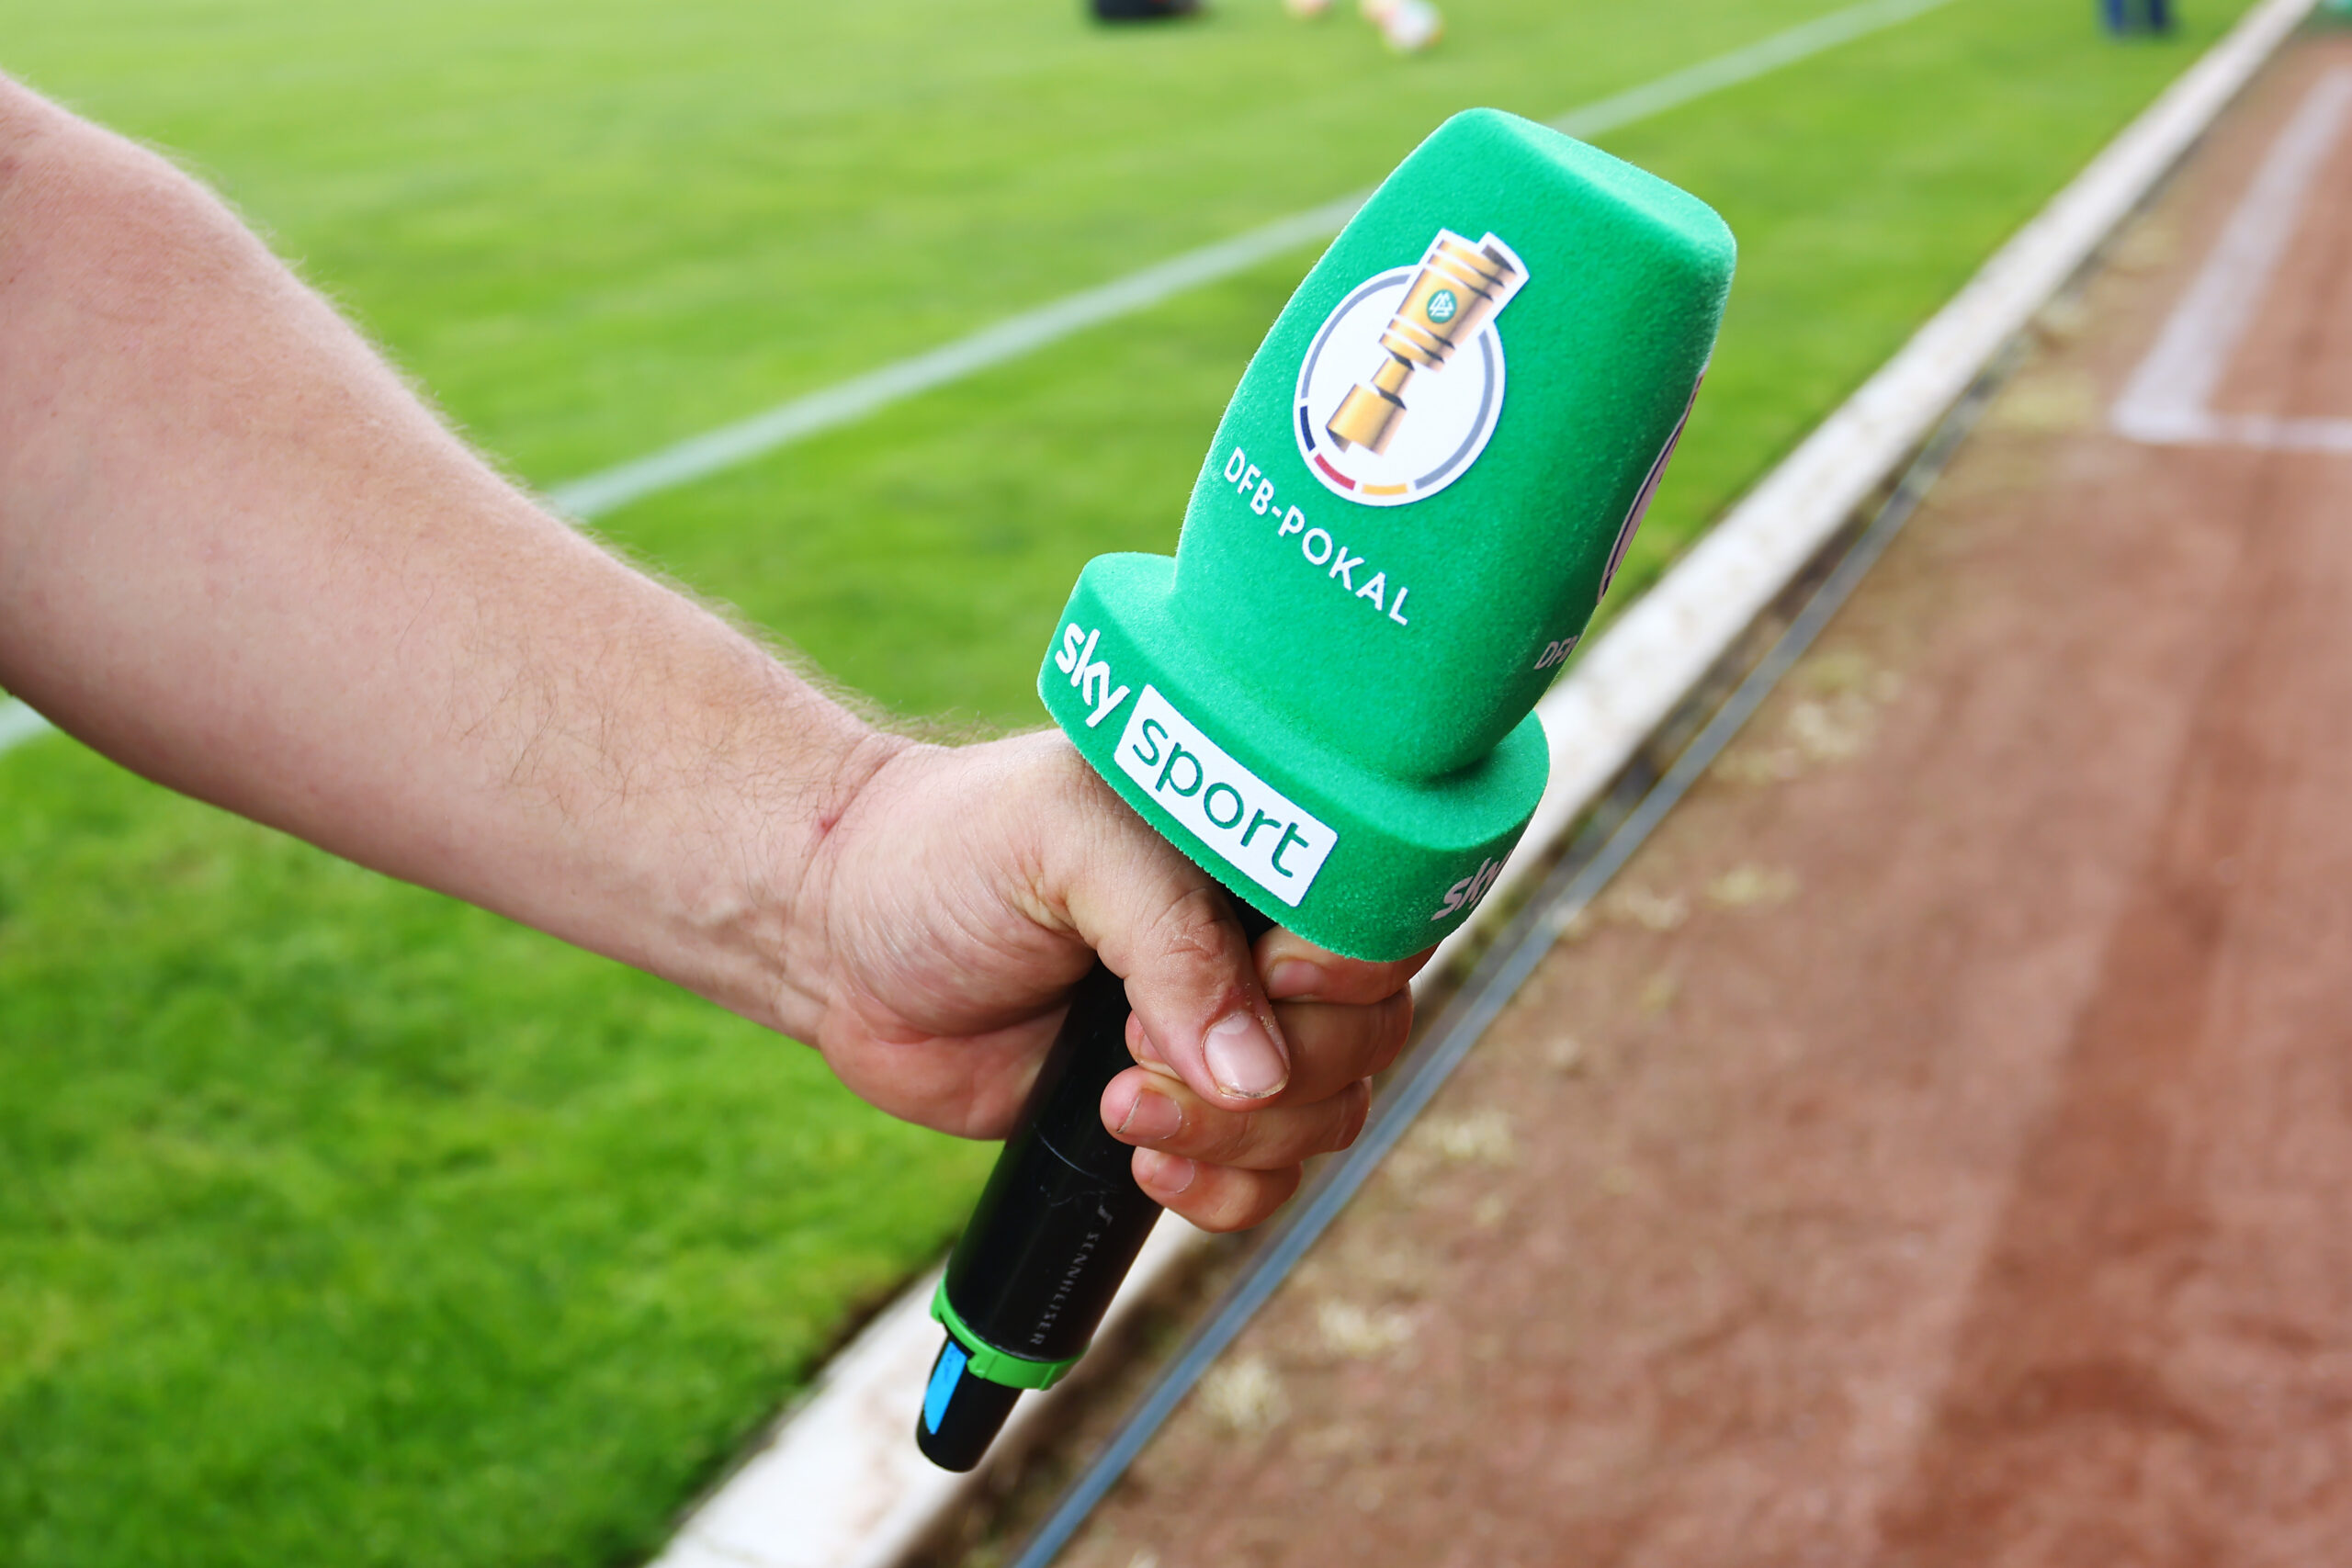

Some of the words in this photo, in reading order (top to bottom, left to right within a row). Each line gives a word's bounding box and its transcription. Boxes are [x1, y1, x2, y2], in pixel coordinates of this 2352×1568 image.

[1223, 446, 1408, 626] DFB-POKAL
[1054, 622, 1131, 728] sky
[1132, 717, 1310, 878] sport
[1029, 1232, 1101, 1345] SENNHEISER
